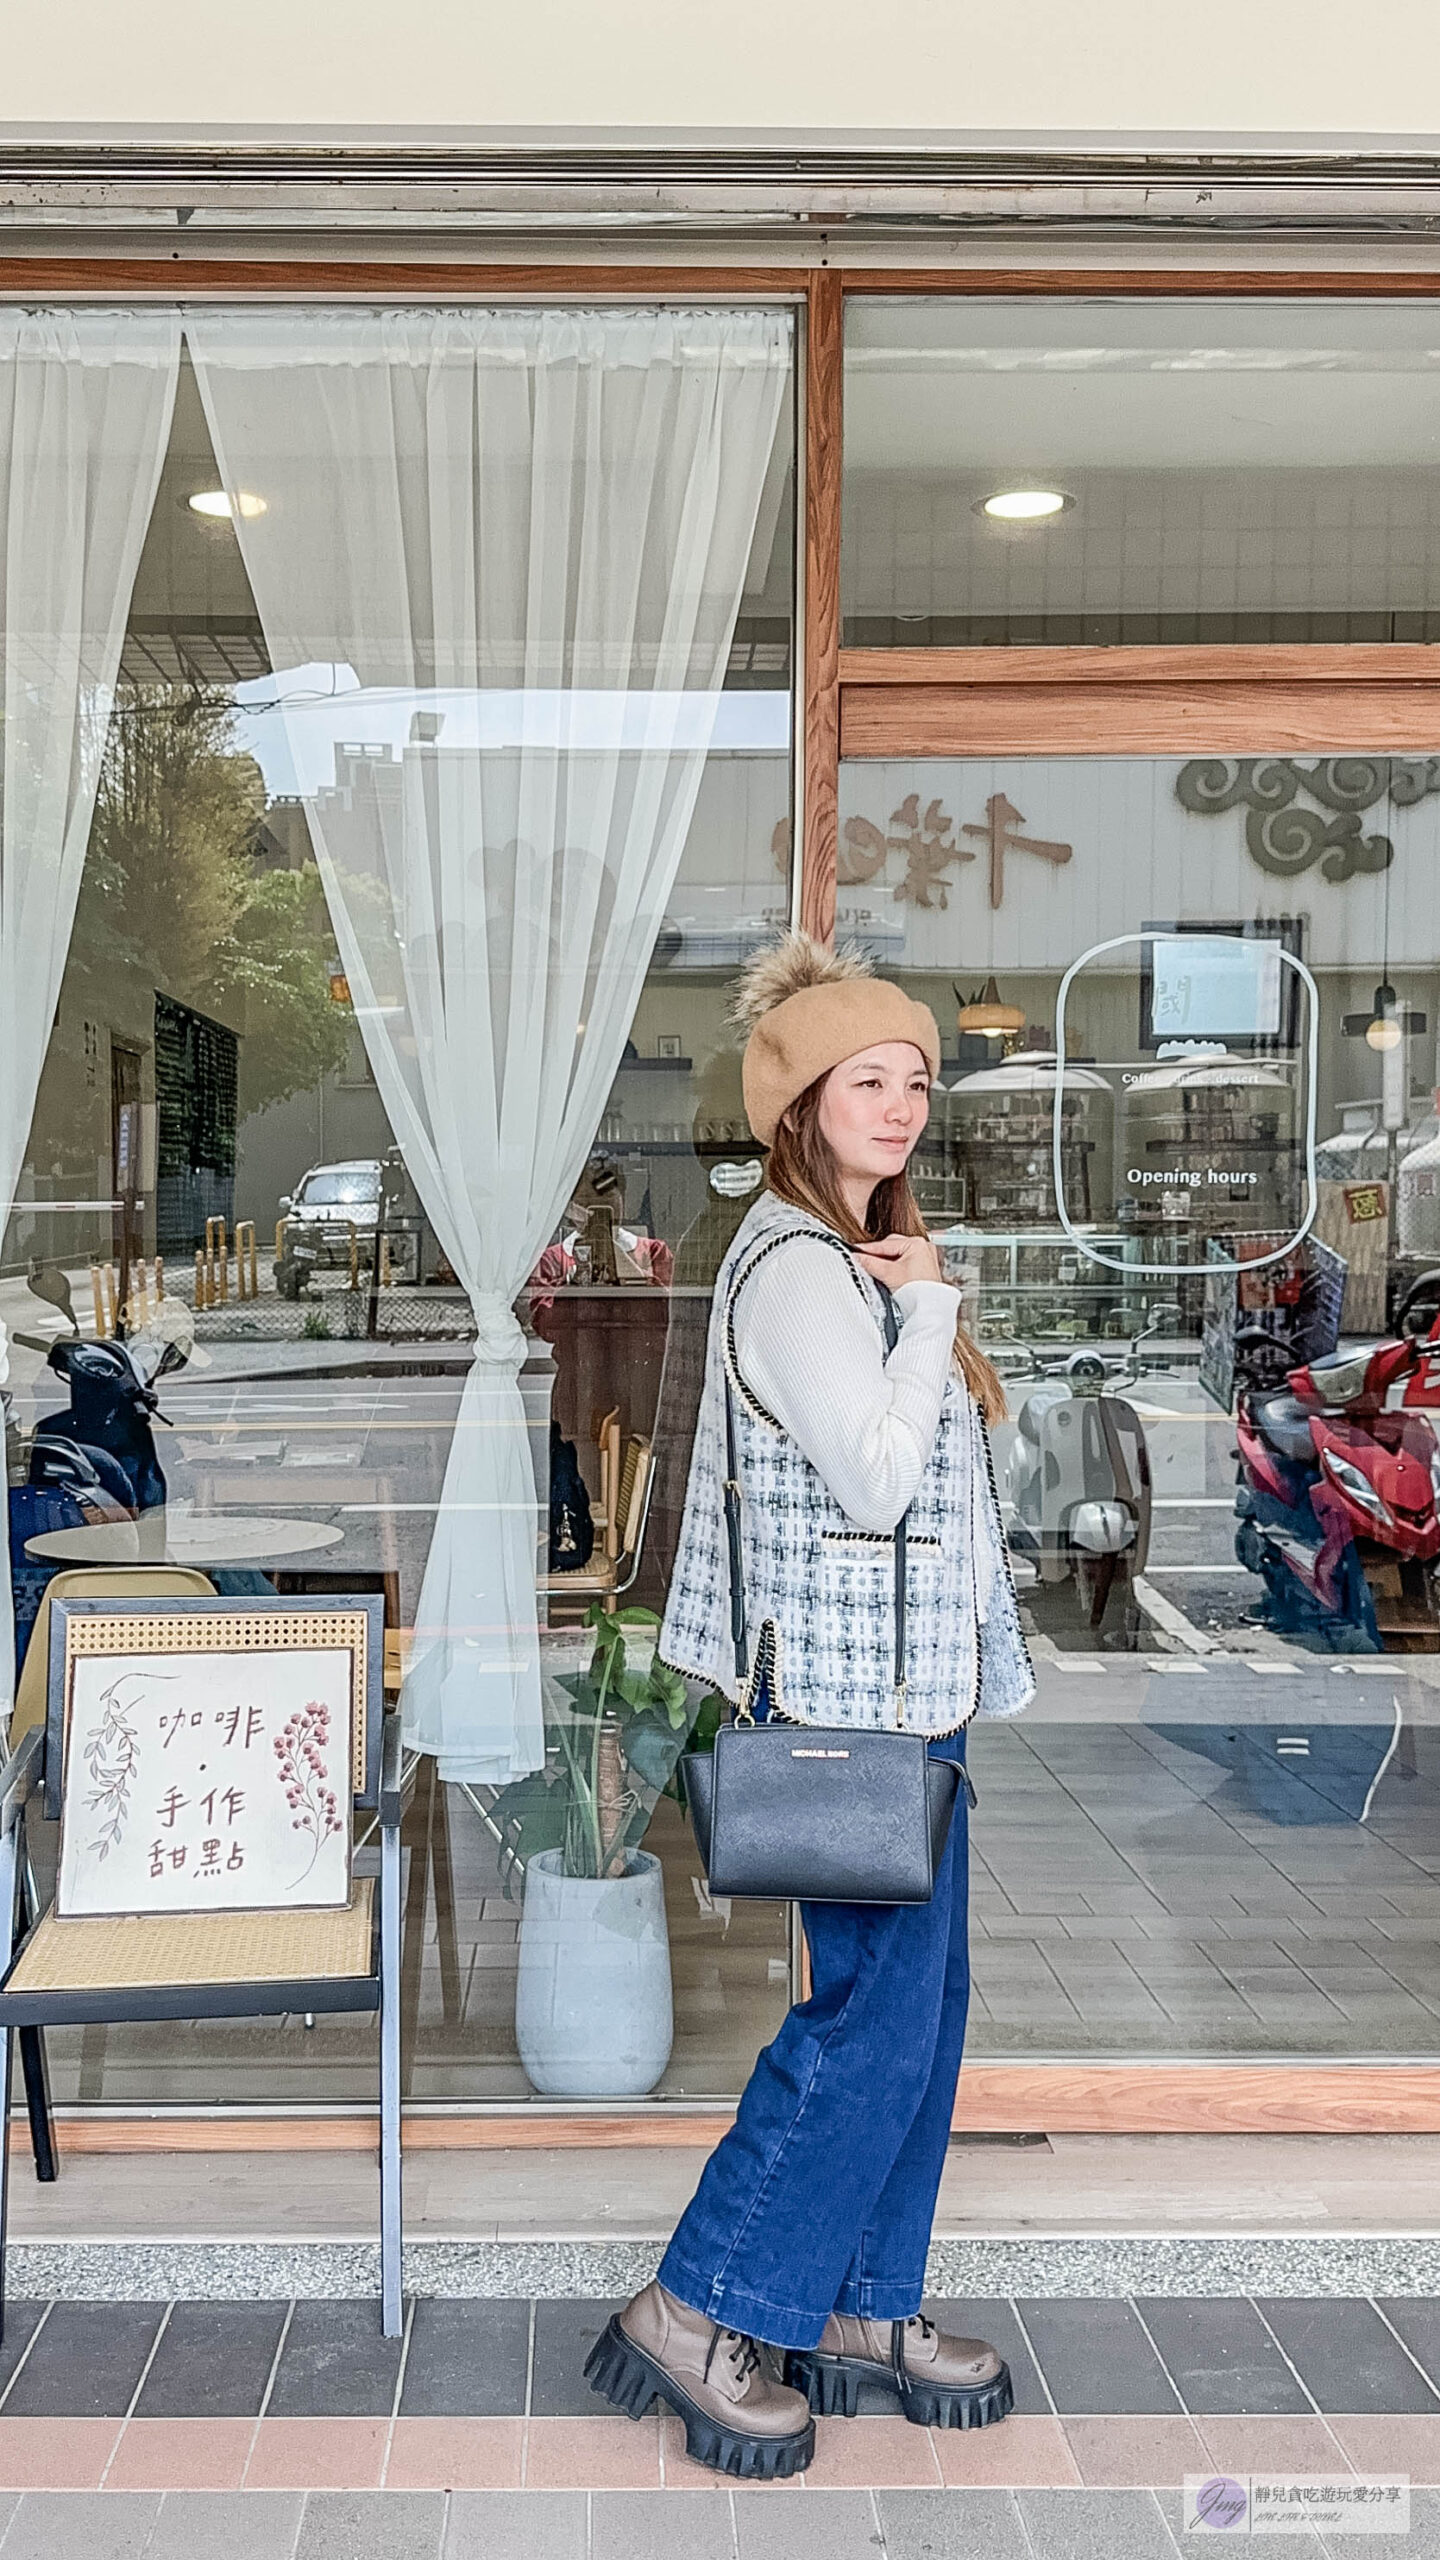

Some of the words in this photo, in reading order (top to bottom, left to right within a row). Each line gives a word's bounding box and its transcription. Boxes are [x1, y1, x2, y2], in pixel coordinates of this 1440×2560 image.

[1122, 1073, 1159, 1085] Coffe
[1215, 1072, 1260, 1085] dessert
[1126, 1167, 1202, 1188] Opening
[1207, 1167, 1258, 1185] hours
[159, 1705, 265, 1749] 咖啡
[791, 1748, 827, 1758] MICHAEL
[156, 1785, 246, 1828] 手作
[148, 1838, 244, 1878] 甜點
